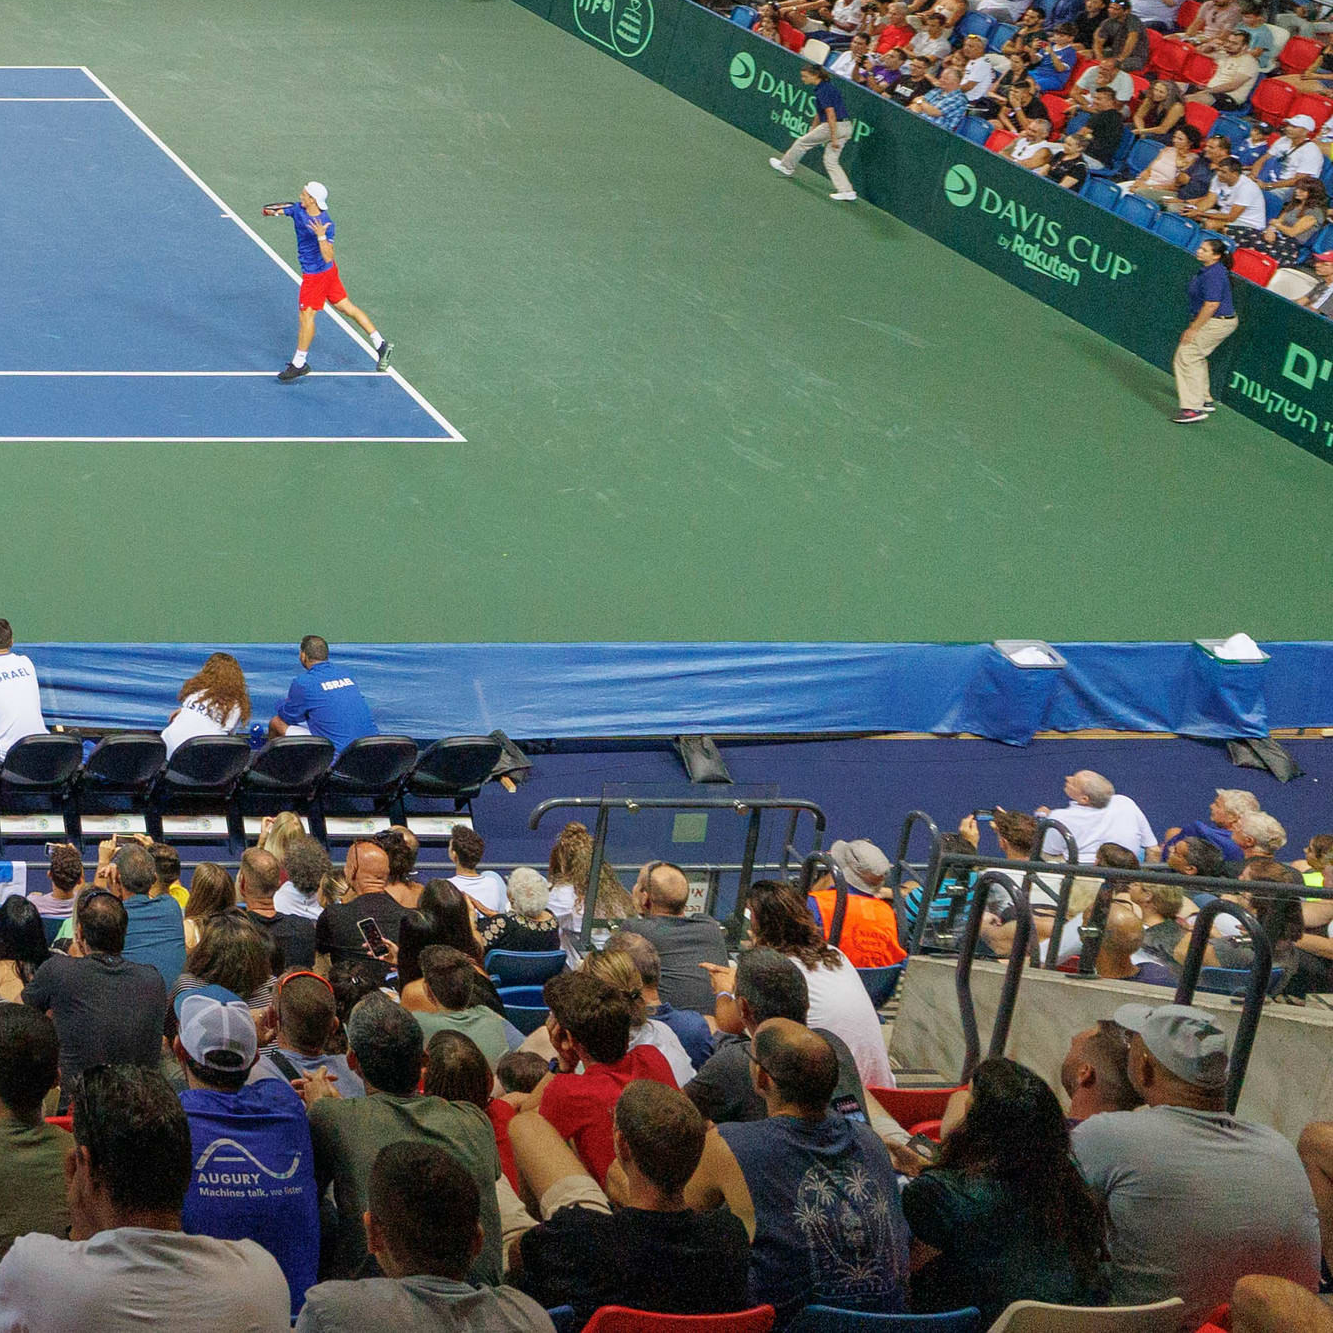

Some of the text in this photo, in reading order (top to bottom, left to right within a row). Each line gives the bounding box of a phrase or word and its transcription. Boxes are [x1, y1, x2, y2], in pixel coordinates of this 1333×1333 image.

[757, 70, 818, 118] DAVIS
[980, 186, 1133, 281] DAVIS CUP
[997, 233, 1081, 287] by Rakuten
[1229, 370, 1318, 434] השקעות
[186, 699, 223, 724] ISRAE
[197, 1172, 260, 1185] AUGURY
[199, 1187, 245, 1198] Machines
[247, 1187, 269, 1198] talk,
[270, 1188, 283, 1196] we
